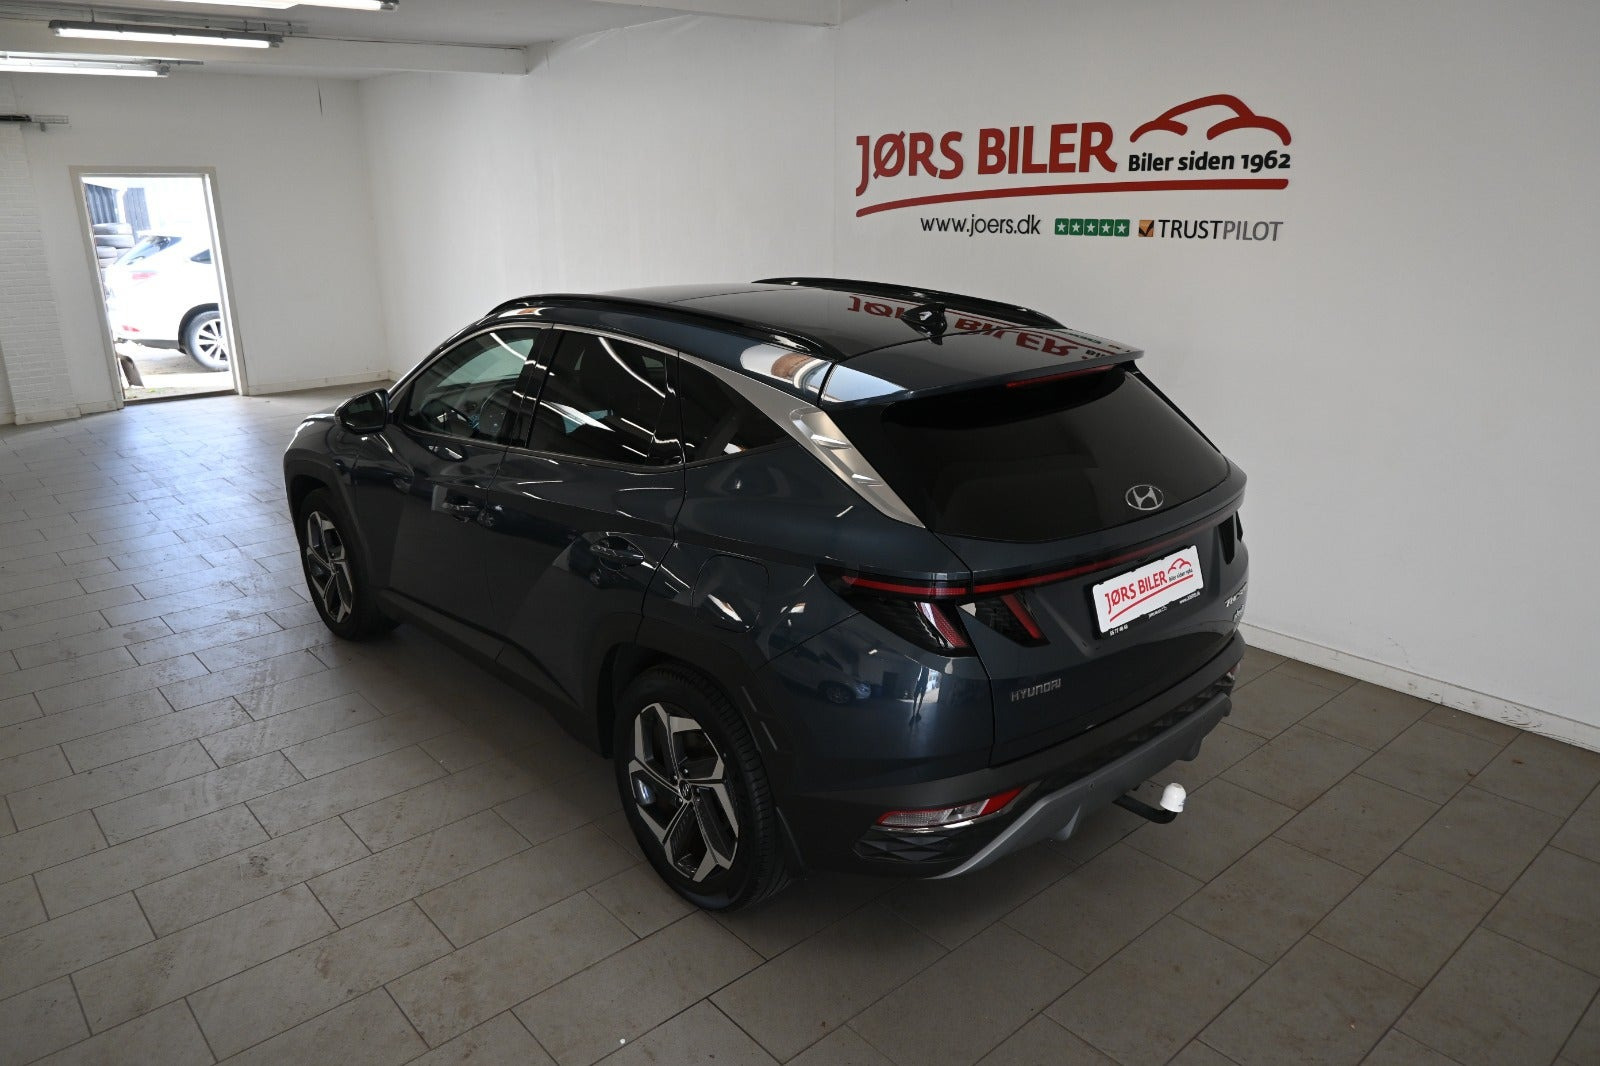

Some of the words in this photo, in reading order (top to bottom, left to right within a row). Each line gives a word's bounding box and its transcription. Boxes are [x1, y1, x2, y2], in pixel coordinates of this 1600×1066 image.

[856, 130, 964, 197] JØRS
[977, 121, 1118, 175] BILER
[1128, 153, 1174, 172] Biler
[1177, 151, 1235, 171] siden
[1241, 150, 1291, 174] 1962
[920, 214, 1042, 238] www.joers.dk
[1158, 219, 1284, 242] TRUSTPILOT
[1104, 583, 1136, 614] JØRS
[1138, 570, 1167, 594] BILER
[1011, 678, 1062, 702] HYUNDAI
